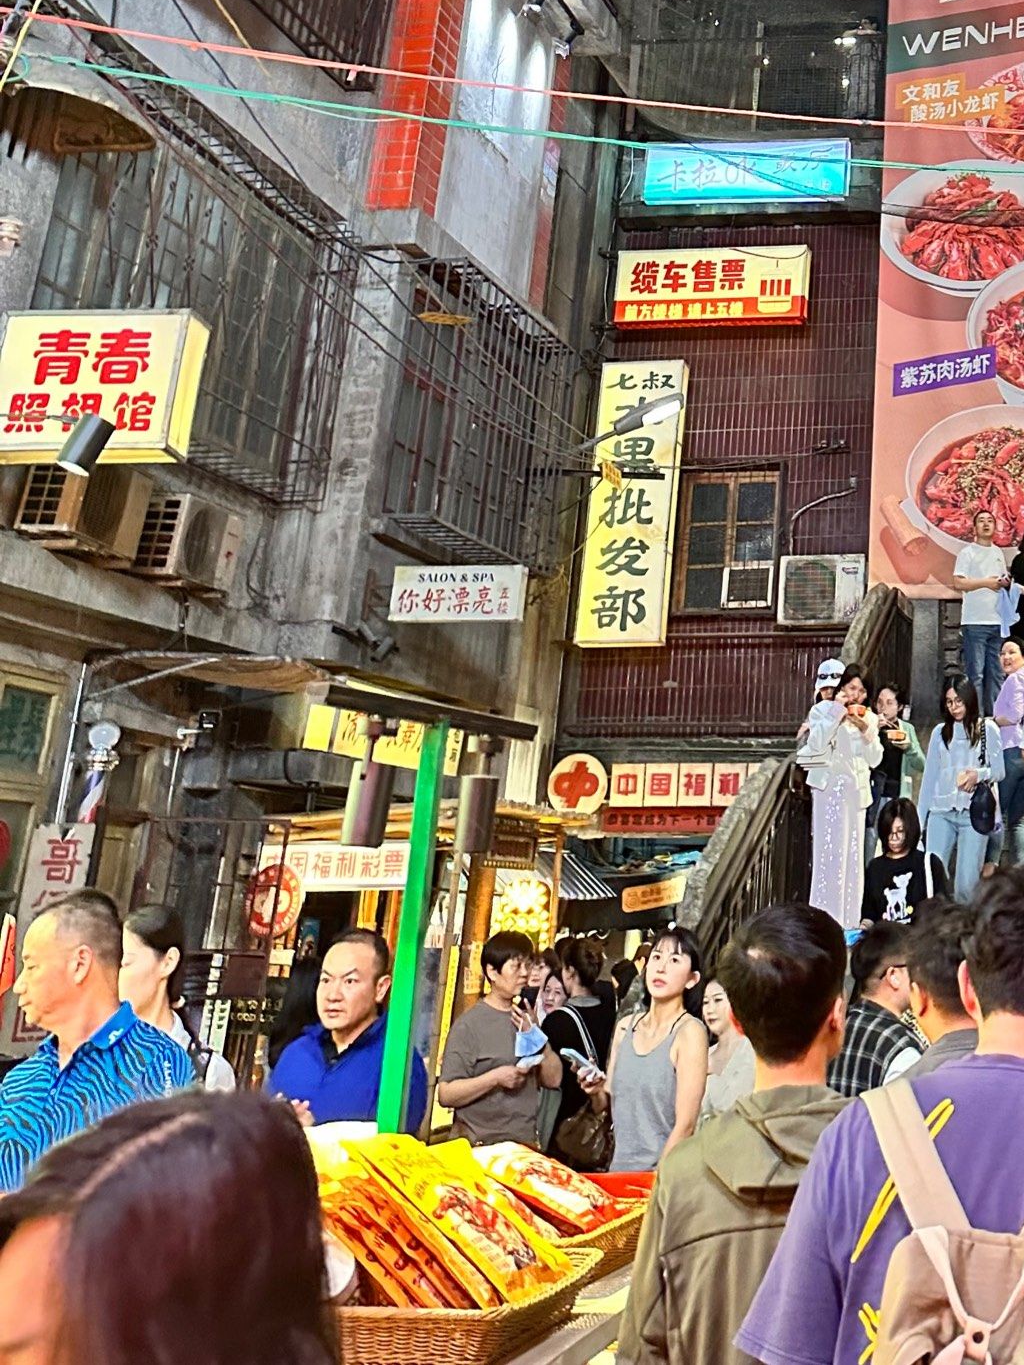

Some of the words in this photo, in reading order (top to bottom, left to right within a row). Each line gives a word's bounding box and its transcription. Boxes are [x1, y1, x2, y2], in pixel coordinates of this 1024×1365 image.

[902, 79, 960, 104] 文和友
[911, 91, 999, 122] 酸汤小龙虾
[630, 259, 746, 295] 缆车售票
[33, 329, 152, 385] 青春
[900, 353, 992, 389] 紫苏肉汤虾
[606, 371, 676, 390] 七叔
[3, 391, 156, 433] 照相馆
[418, 572, 456, 583] SALON
[460, 573, 469, 583] &
[472, 572, 495, 583] SPA
[398, 586, 494, 615] 你好漂亮
[616, 773, 740, 796] 中国福利
